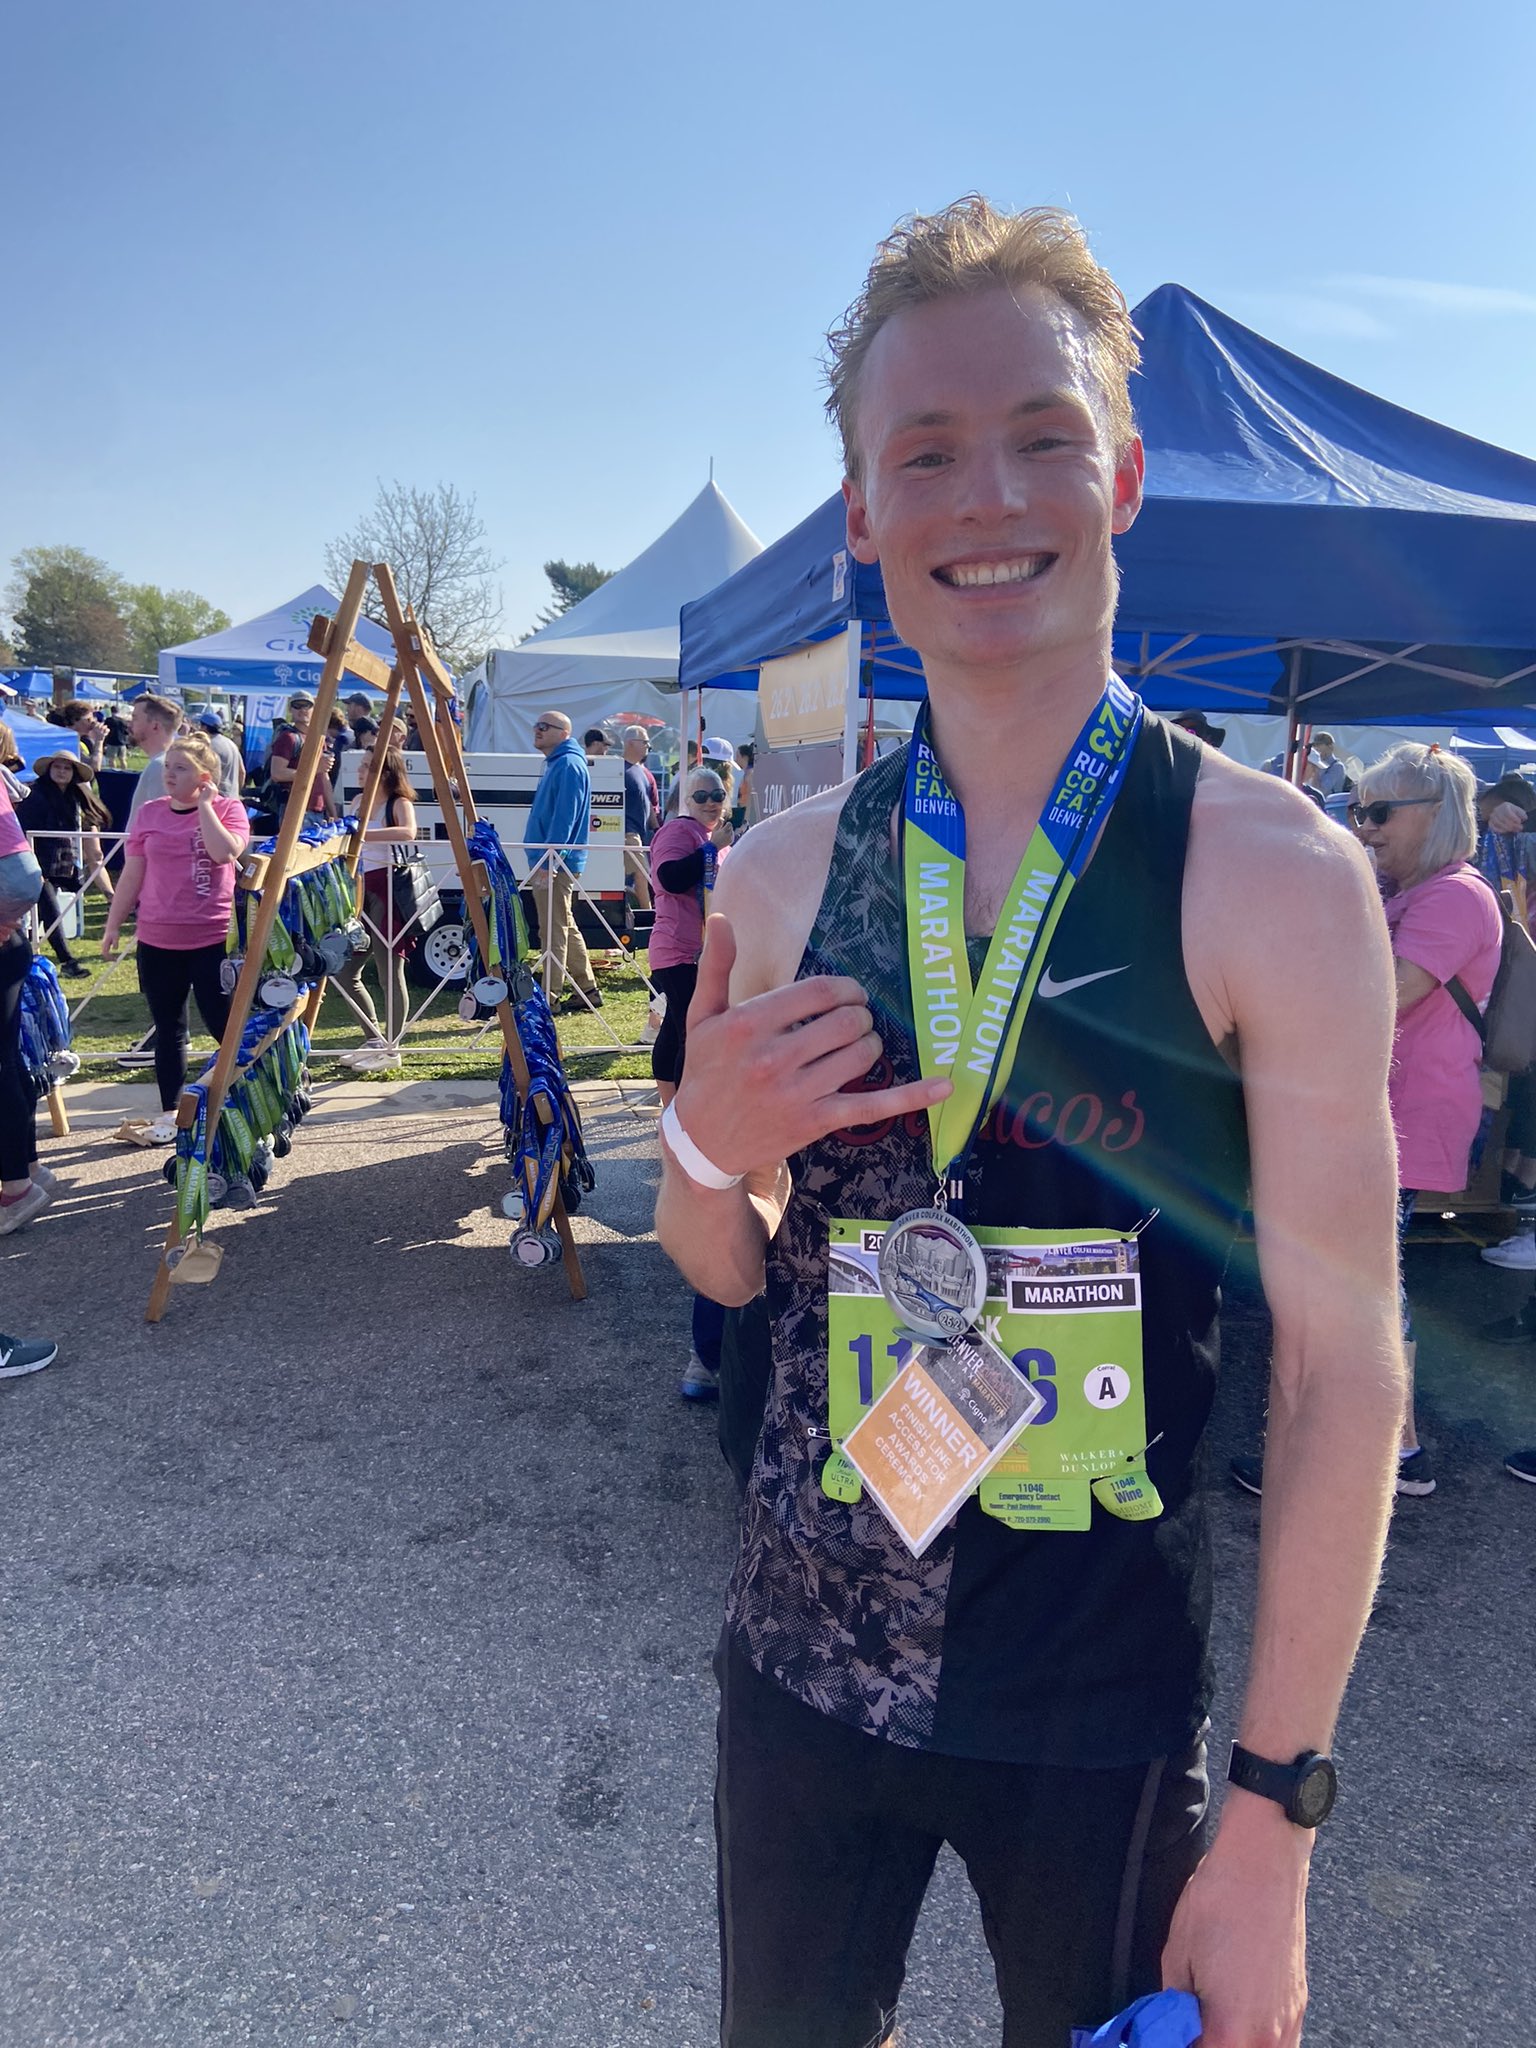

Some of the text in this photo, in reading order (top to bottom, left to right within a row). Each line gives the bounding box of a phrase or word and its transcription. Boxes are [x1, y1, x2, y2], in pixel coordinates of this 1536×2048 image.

[266, 639, 314, 655] Cig
[297, 669, 321, 684] Cig
[918, 743, 938, 765] RU
[916, 760, 943, 780] CO
[1066, 770, 1097, 794] CO
[763, 784, 783, 814] 10M
[915, 798, 957, 817] DENVER
[196, 858, 212, 897] CREW
[919, 862, 962, 1065] MARATHON
[967, 869, 1058, 1075] MARATHON
[898, 1211, 974, 1248] DENVER COLFAX MARATHON
[868, 1235, 884, 1250] 20
[1024, 1284, 1124, 1303] MARATHON
[941, 1314, 961, 1330] 26.2
[946, 1348, 975, 1381] OLFAX
[971, 1379, 1008, 1418] MARATHON
[1099, 1377, 1117, 1400] A
[903, 1371, 977, 1470] WINNER
[968, 1399, 987, 1424] Cigna
[900, 1403, 953, 1469] FINISH LINE
[888, 1412, 947, 1485] ACCESS FOR
[888, 1433, 929, 1484] AWARDS
[1060, 1449, 1115, 1462] WALKER
[875, 1437, 925, 1500] CEREMONY
[1062, 1462, 1117, 1473] DUNLOP
[831, 1473, 854, 1486] ULTRA
[1018, 1484, 1044, 1493] 11046
[1110, 1477, 1136, 1491] 11046
[999, 1493, 1061, 1501] Emergency Contact
[1114, 1488, 1143, 1504] Wine
